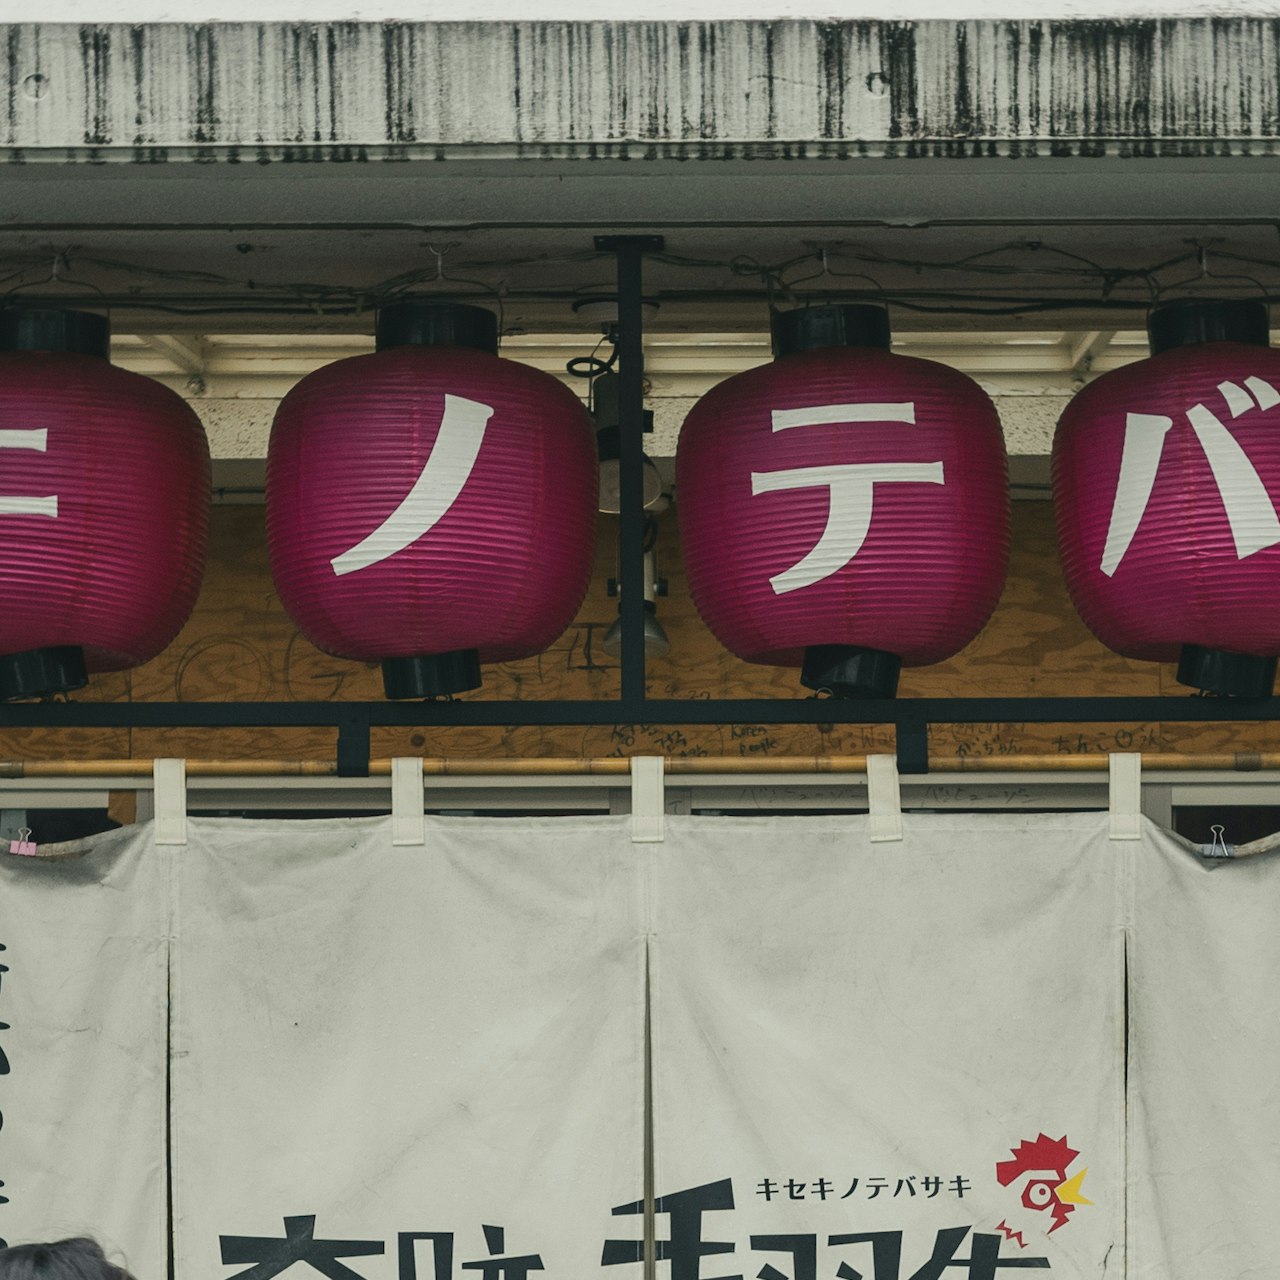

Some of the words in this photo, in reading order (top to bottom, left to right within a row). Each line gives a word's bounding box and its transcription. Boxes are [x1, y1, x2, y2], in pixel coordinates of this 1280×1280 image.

[330, 393, 495, 576] ノ
[751, 401, 945, 595] テ
[756, 1175, 972, 1201] キセキノテバサキ
